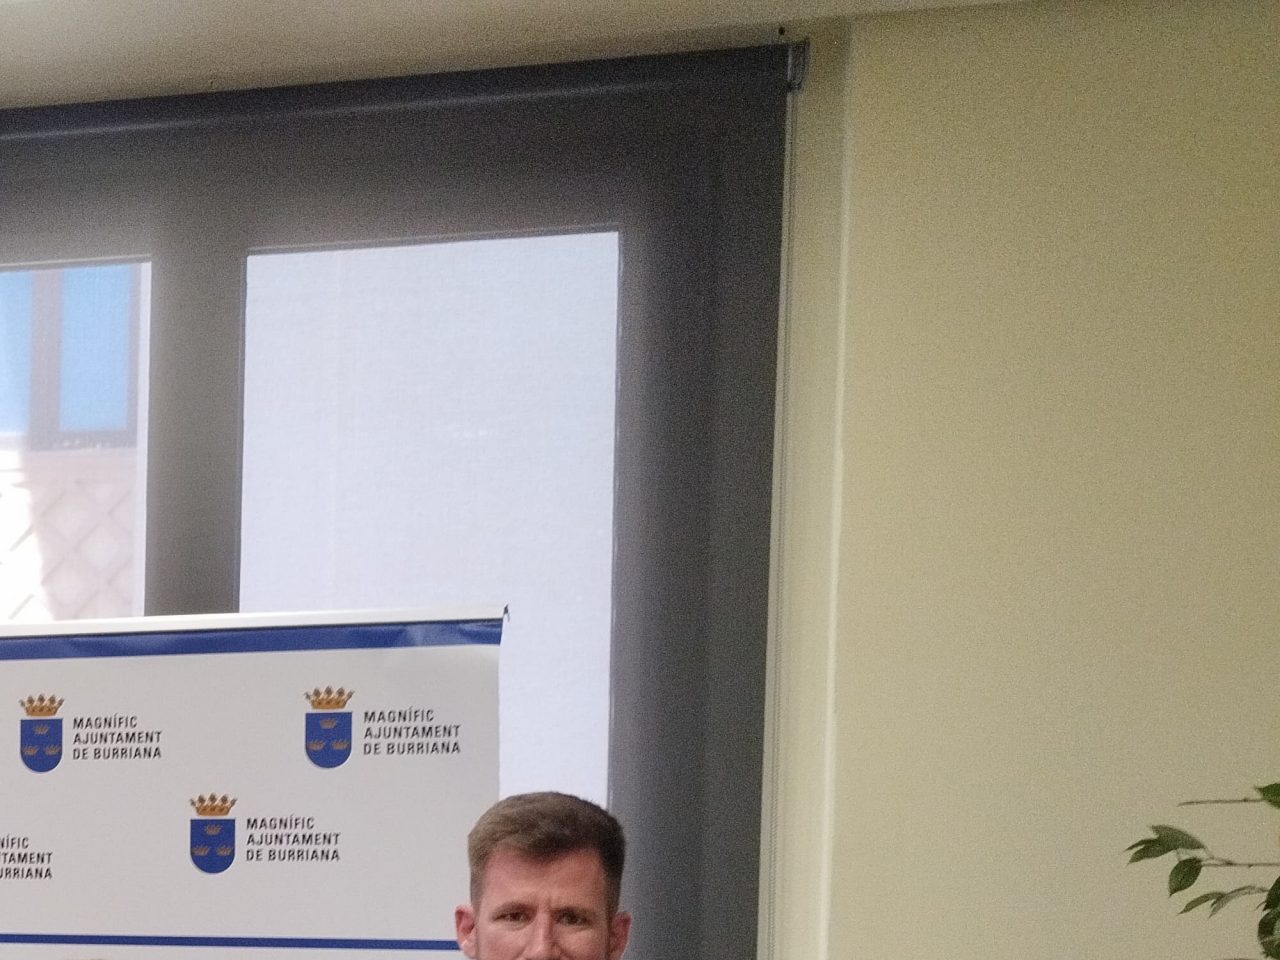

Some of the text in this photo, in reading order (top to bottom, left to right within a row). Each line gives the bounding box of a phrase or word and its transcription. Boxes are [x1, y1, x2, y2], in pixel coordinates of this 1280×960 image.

[72, 713, 138, 729] MAGNÍFIC
[363, 706, 434, 723] MAGNÍFIC
[73, 730, 162, 744] AJUNTAMENT
[363, 725, 461, 739] AJUNTAMENT
[73, 747, 162, 760] DE BURRIANA
[363, 742, 461, 755] DE BURRIANA
[246, 814, 314, 830] MAGNÍFIC
[246, 832, 340, 846] AJUNTAMENT
[246, 849, 340, 861] DE BURRIANA
